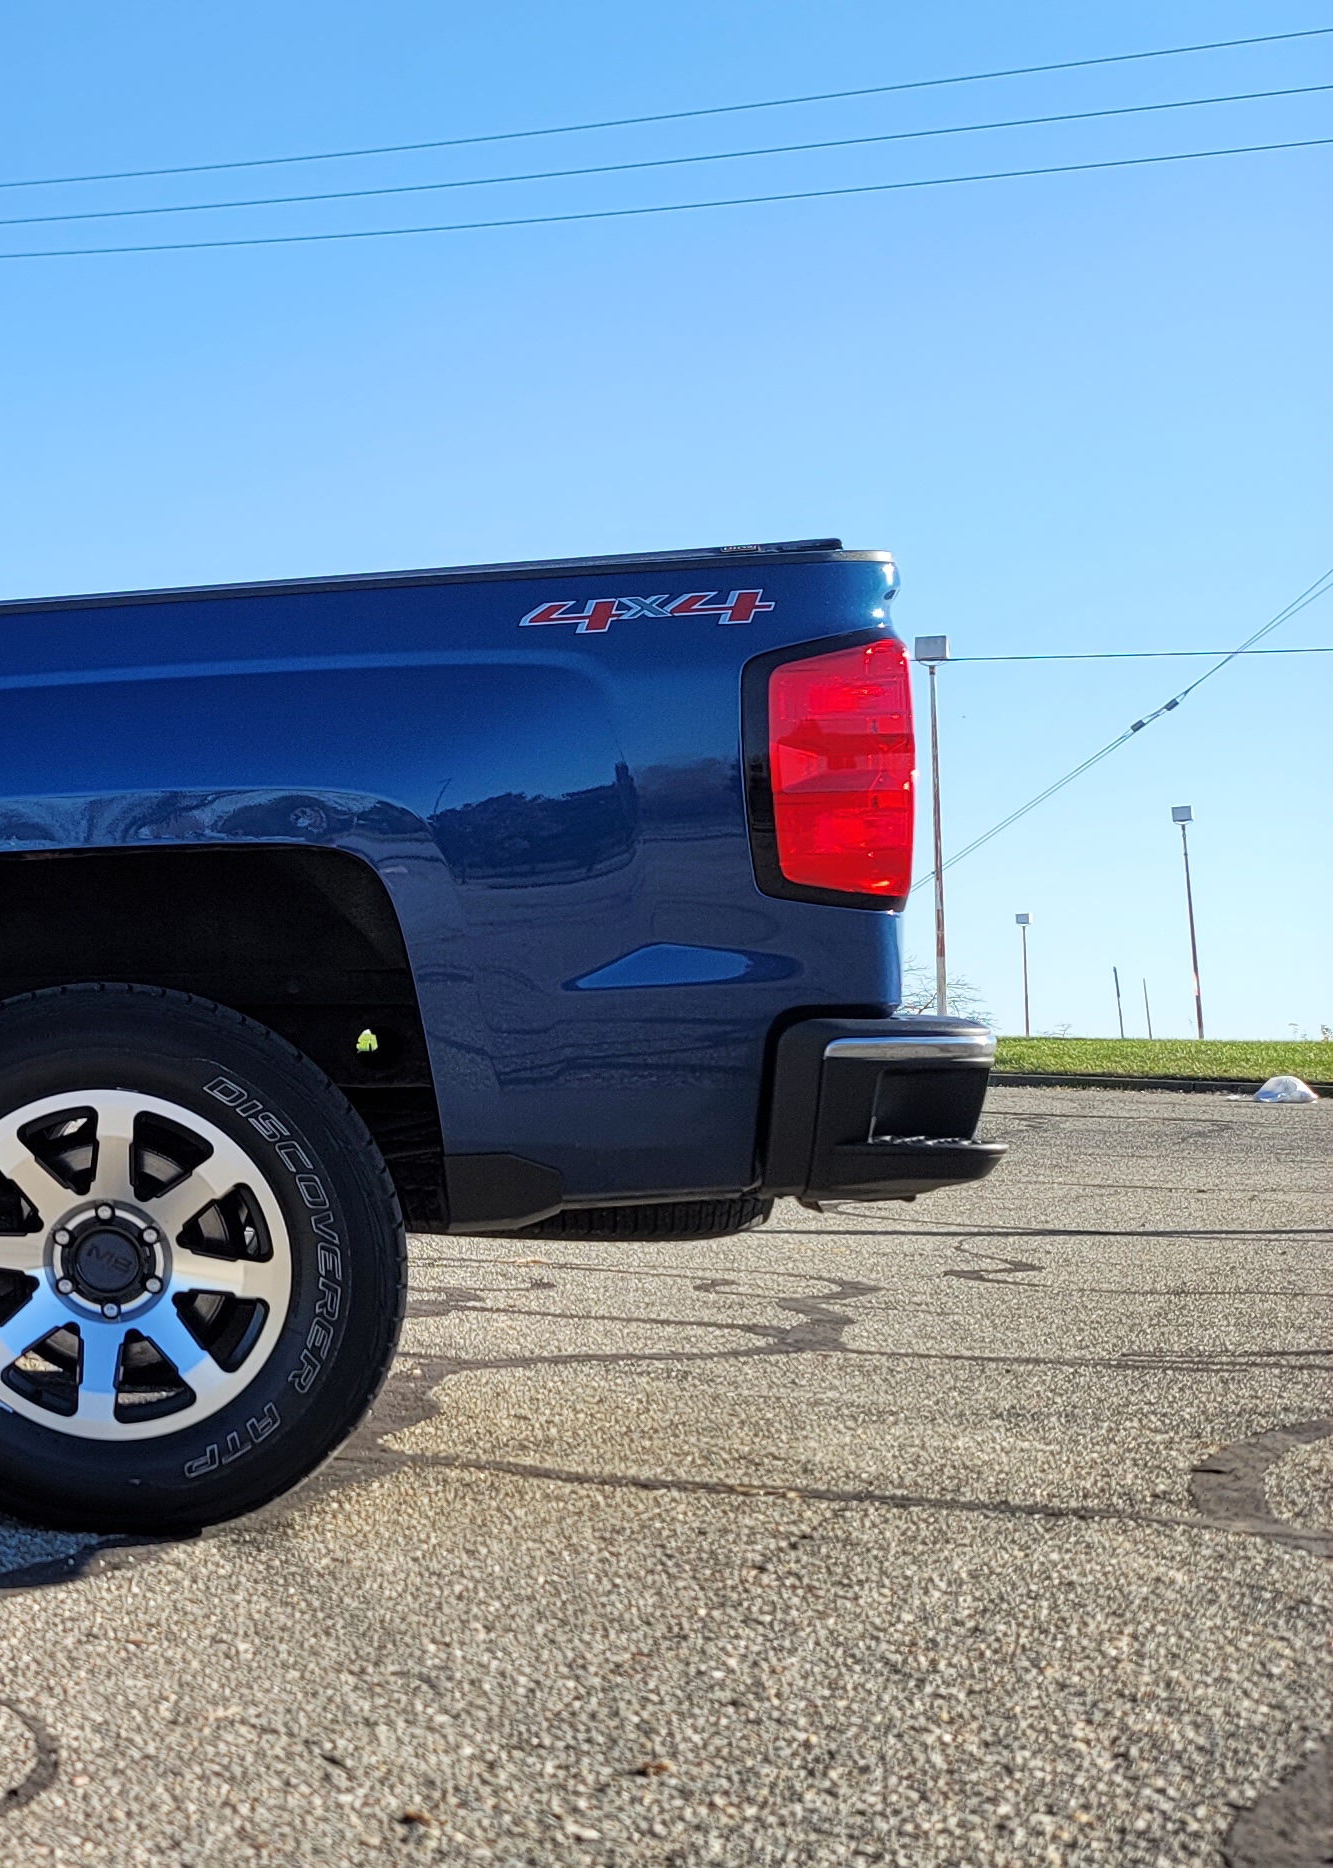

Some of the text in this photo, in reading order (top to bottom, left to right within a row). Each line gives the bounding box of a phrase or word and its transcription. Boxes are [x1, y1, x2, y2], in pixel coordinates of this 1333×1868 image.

[519, 588, 776, 634] 4x4
[183, 1075, 343, 1479] DISCOVERER ATP
